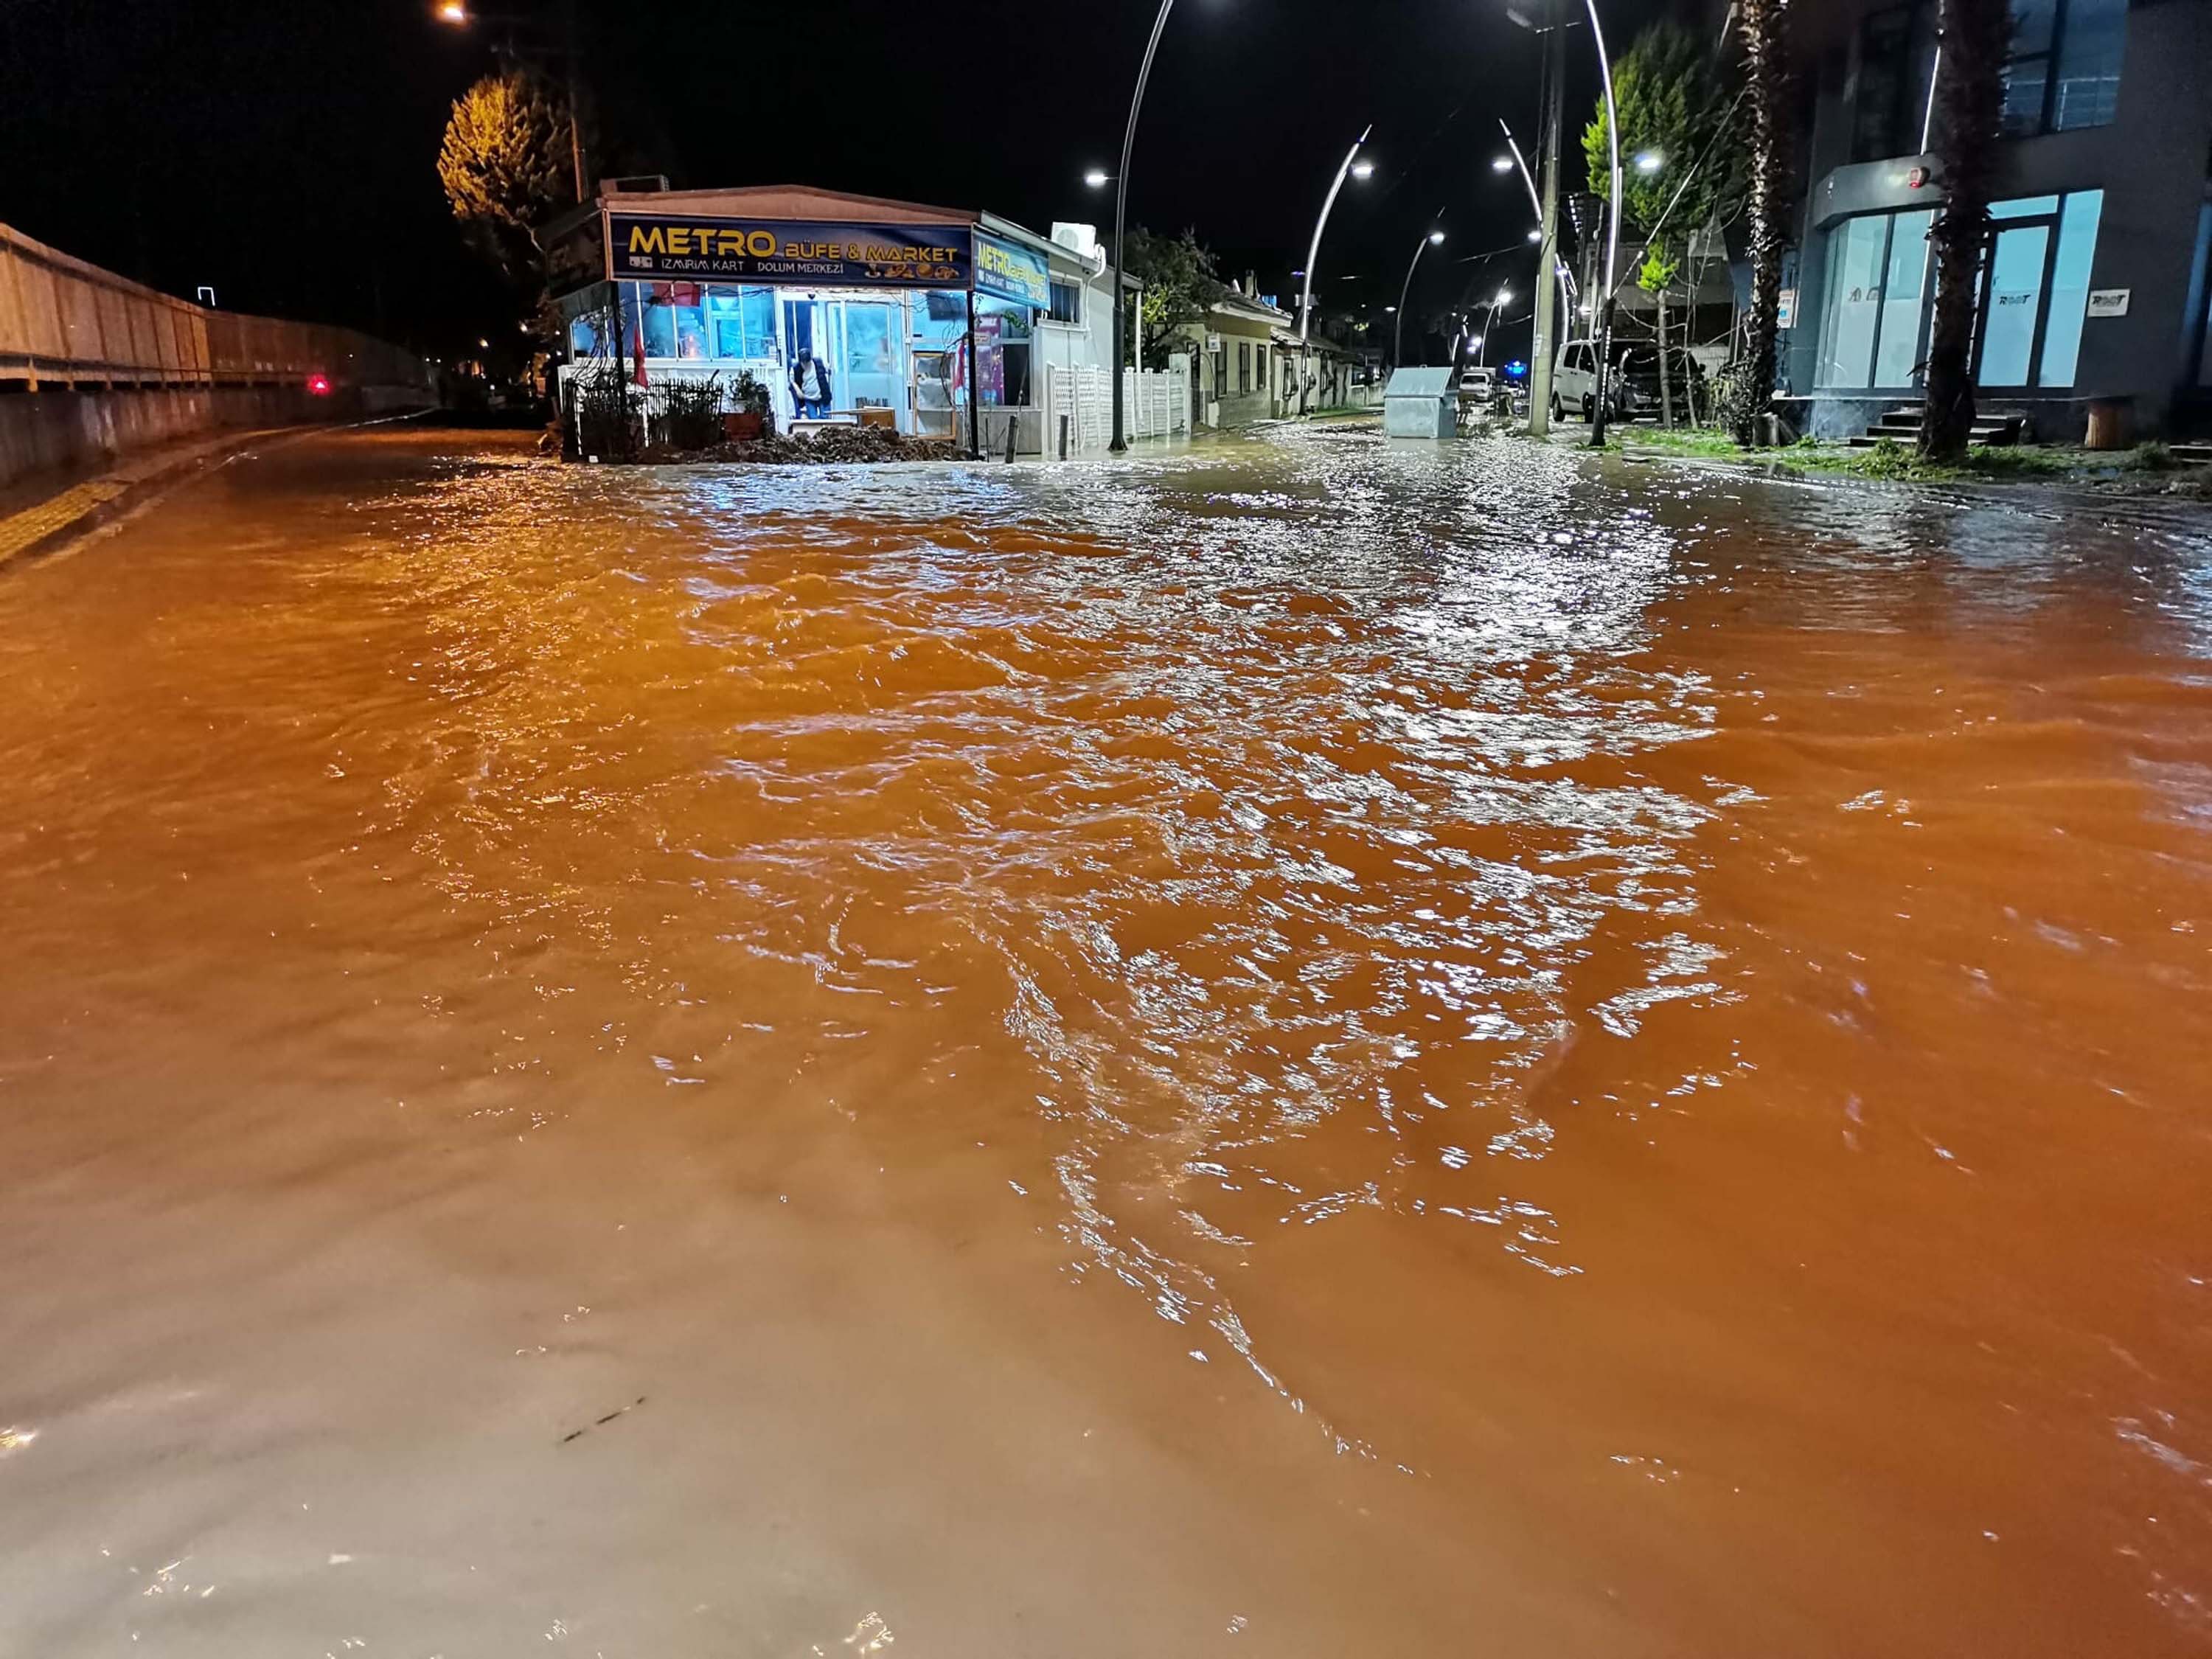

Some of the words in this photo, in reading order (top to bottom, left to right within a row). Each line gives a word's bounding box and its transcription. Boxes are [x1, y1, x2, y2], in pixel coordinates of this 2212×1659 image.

[629, 226, 776, 257] METRO
[785, 240, 840, 259] BÜFE
[847, 244, 860, 260] &
[866, 246, 958, 262] MARKET
[978, 241, 1011, 276] METRO
[713, 261, 745, 271] KART
[758, 262, 795, 273] DOLUM
